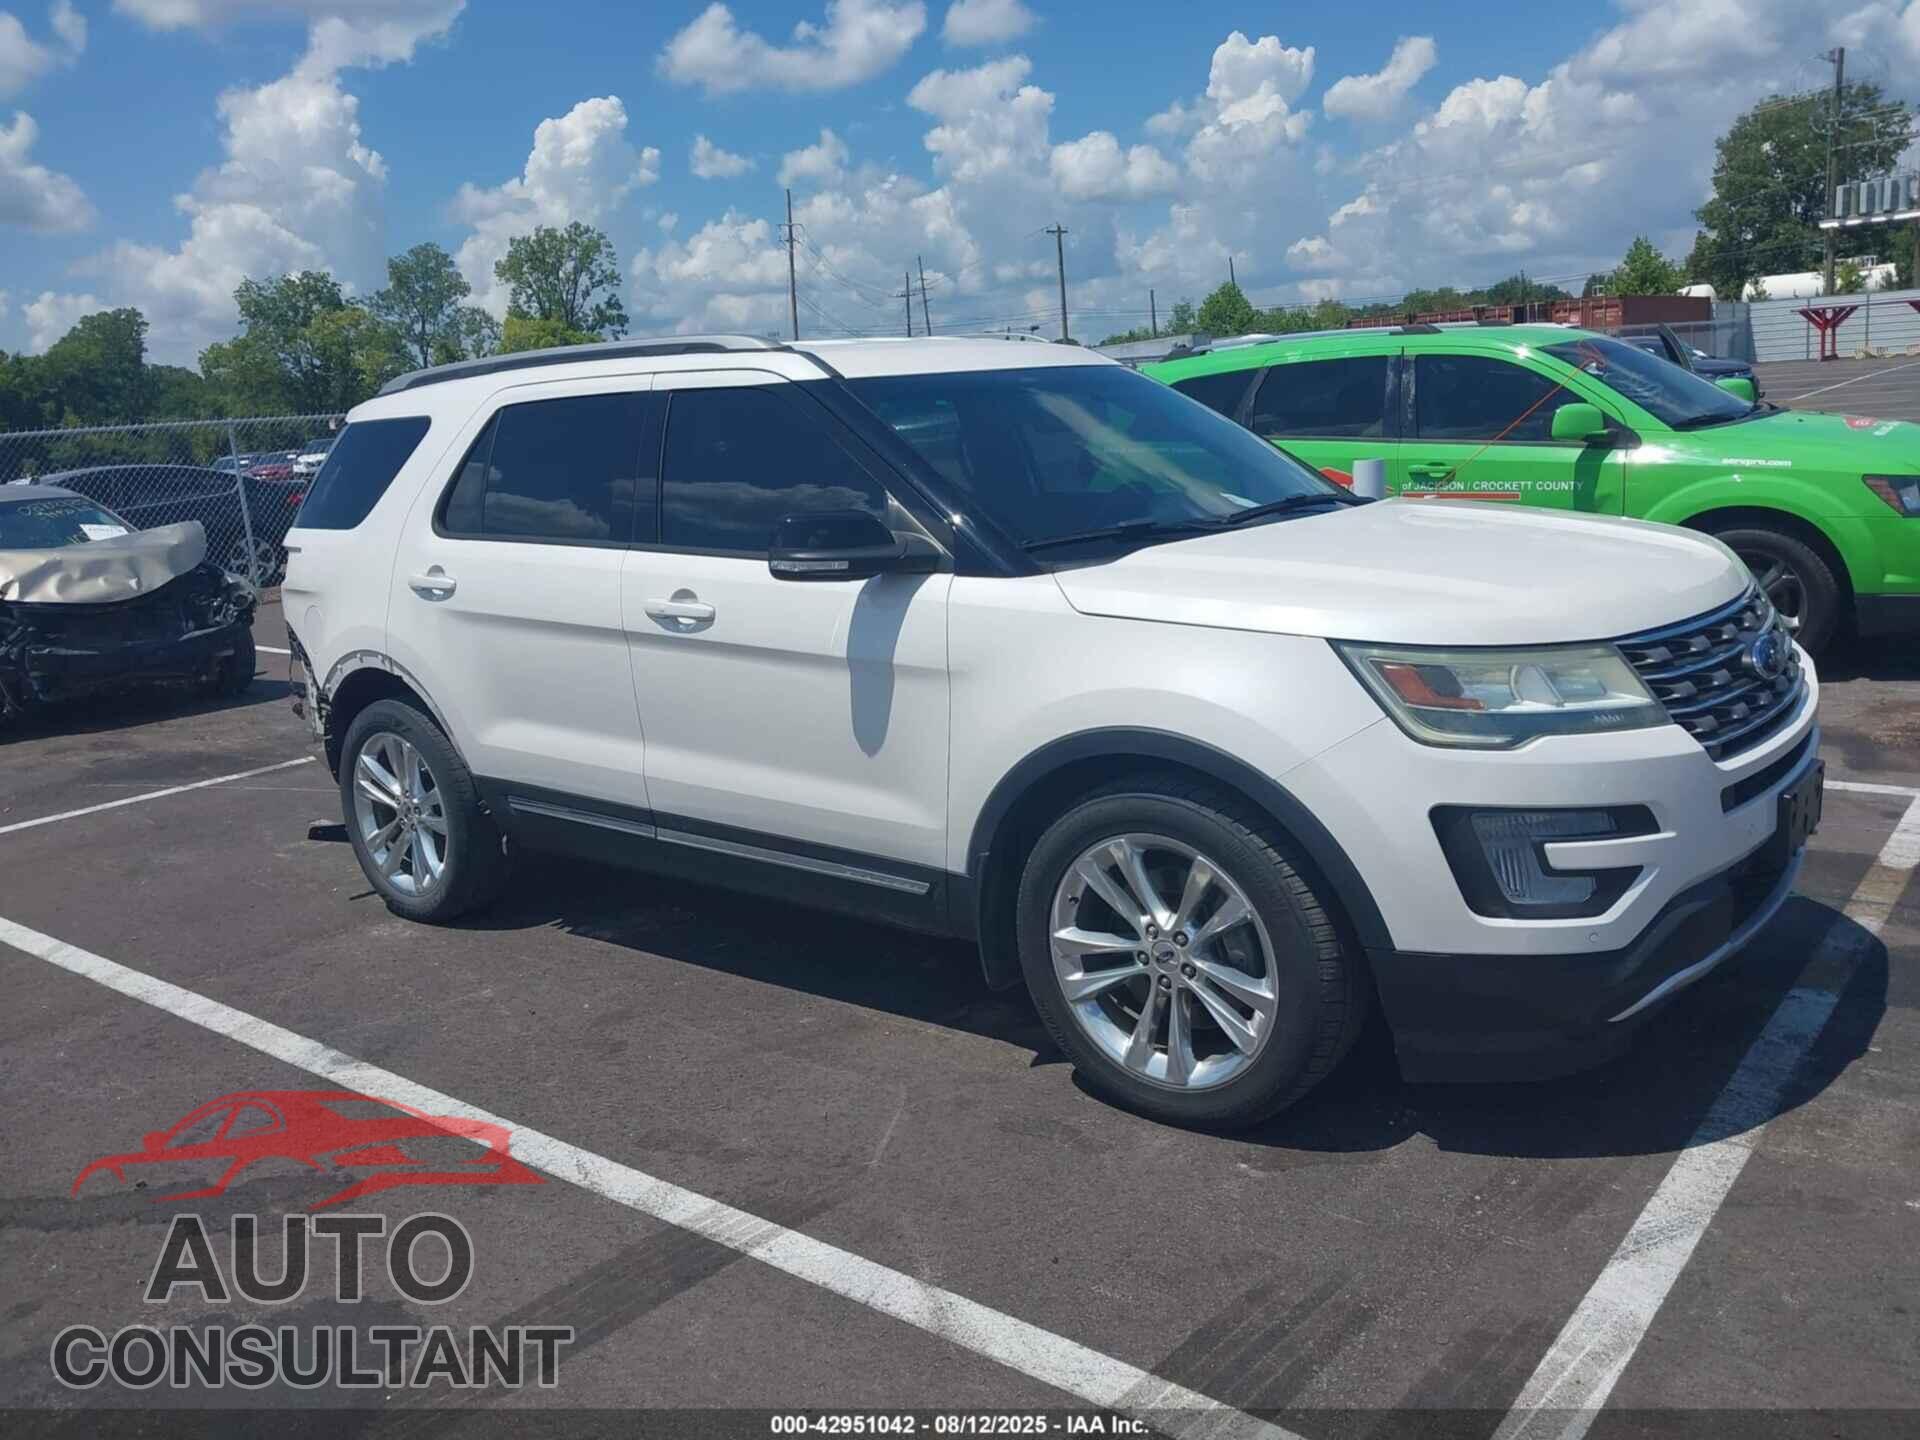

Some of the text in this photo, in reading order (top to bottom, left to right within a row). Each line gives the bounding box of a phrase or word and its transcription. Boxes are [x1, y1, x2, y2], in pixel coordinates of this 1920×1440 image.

[1401, 481, 1411, 490] of
[1414, 480, 1465, 491] JACKSON
[1472, 480, 1532, 491] CROCKETT
[1535, 480, 1584, 491] COUNTY
